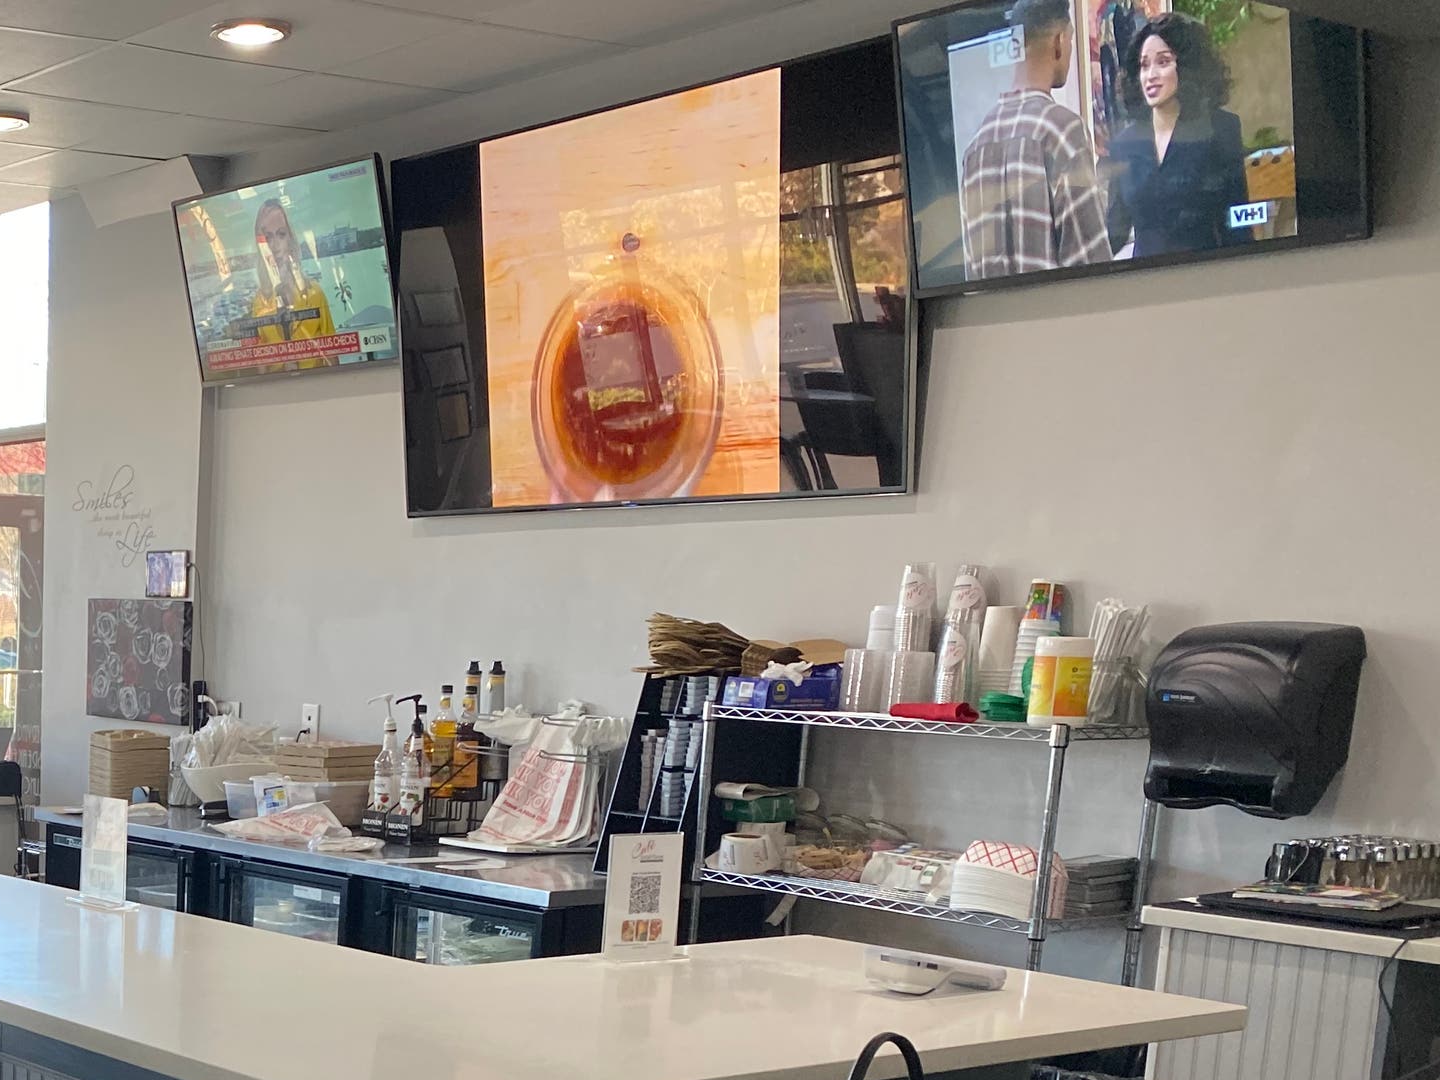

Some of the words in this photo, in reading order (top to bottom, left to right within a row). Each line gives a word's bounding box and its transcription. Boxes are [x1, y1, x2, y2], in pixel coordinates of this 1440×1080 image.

[992, 39, 1022, 64] PG
[253, 345, 278, 358] DECISION
[279, 344, 288, 354] ON
[333, 334, 357, 347] CHECKS
[369, 334, 388, 345] CBSN
[72, 464, 135, 512] Smiles
[116, 521, 157, 568] Life
